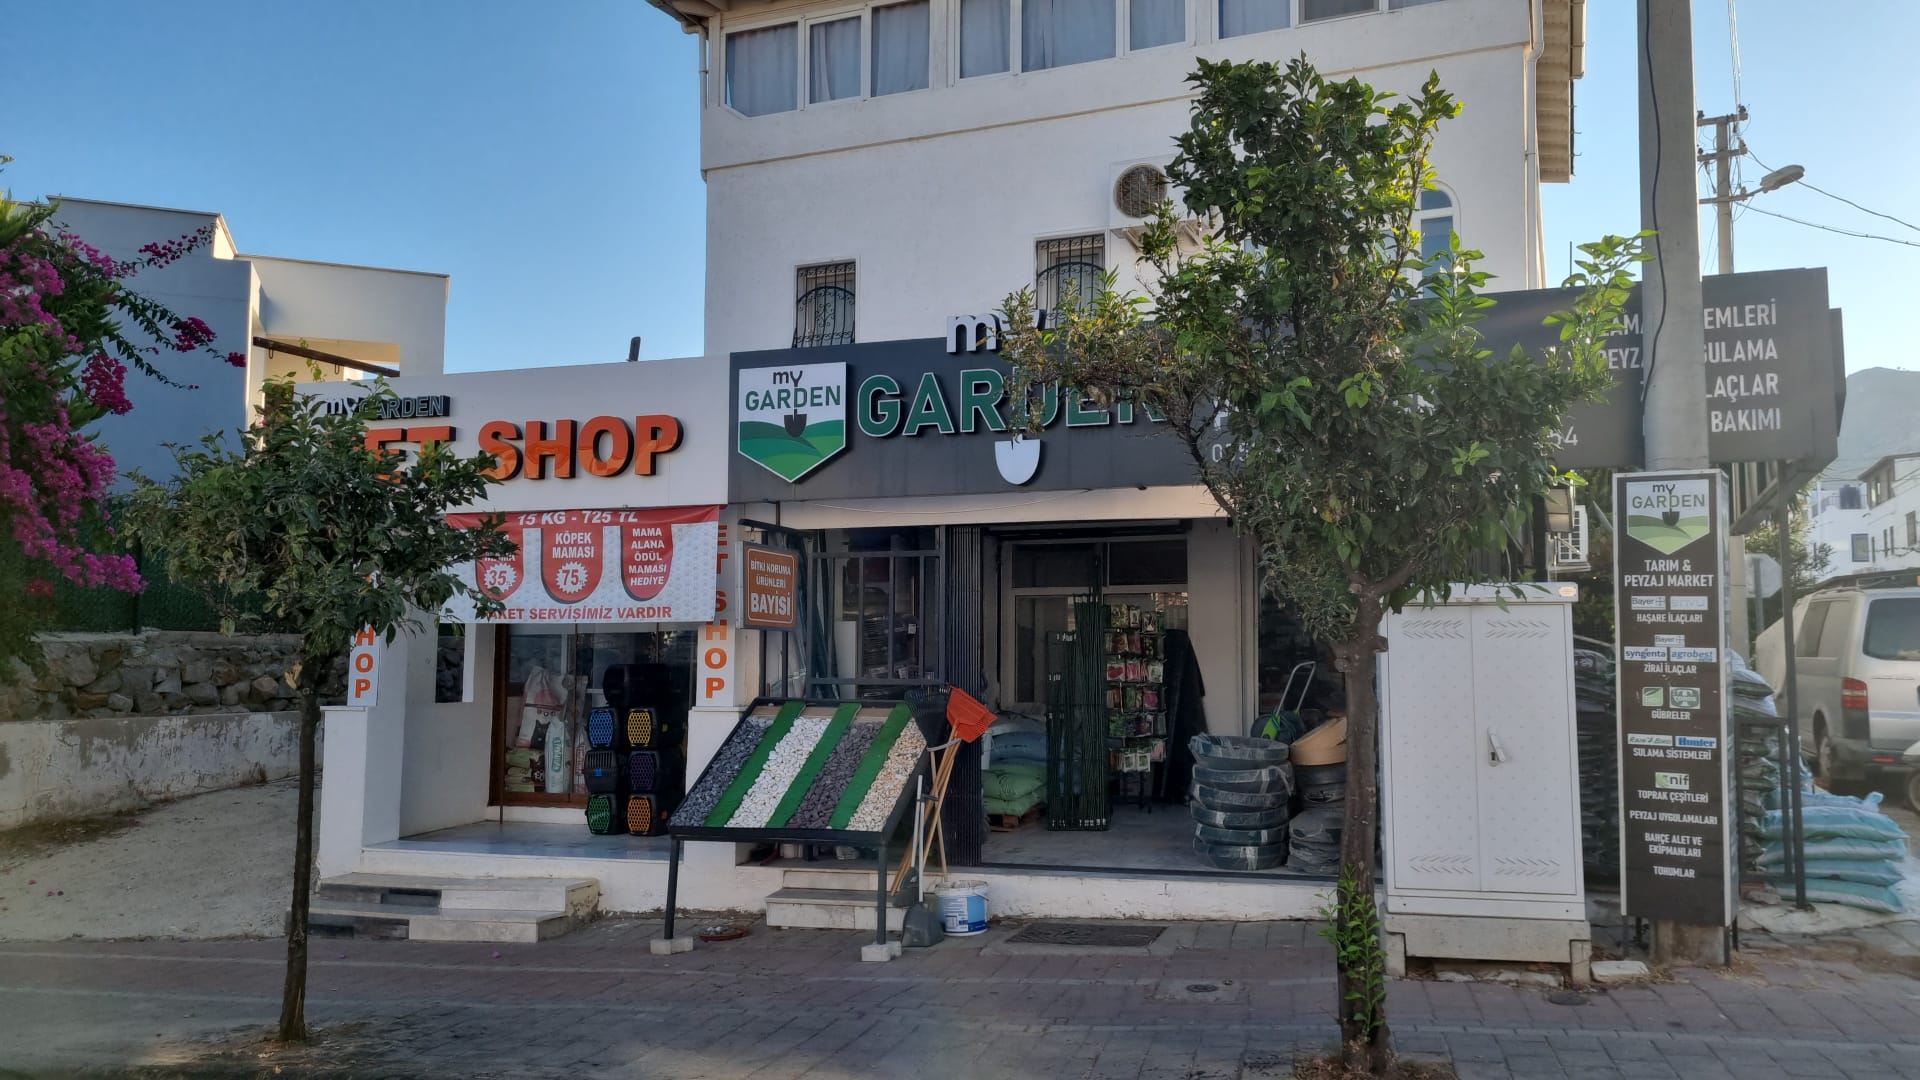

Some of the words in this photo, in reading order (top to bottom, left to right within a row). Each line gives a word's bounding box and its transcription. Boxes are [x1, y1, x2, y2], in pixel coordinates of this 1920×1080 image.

[1703, 298, 1777, 330] EMLERİ
[1703, 339, 1779, 364] ULAMA
[773, 365, 803, 387] my
[1705, 372, 1779, 403] AÇLAR
[745, 385, 841, 411] GARDEN
[1710, 407, 1781, 433] BAKIMI
[477, 414, 684, 482] SHOP
[1652, 484, 1675, 495] my
[1632, 494, 1705, 509] GARDEN
[518, 513, 537, 526] 15
[541, 511, 567, 525] KG
[582, 510, 613, 524] 725
[555, 530, 592, 545] KÖPEK
[632, 527, 662, 537] MAMA
[631, 540, 665, 550] ALANA
[552, 546, 595, 559] MAMASI
[634, 550, 662, 562] ÖDÜL
[628, 564, 667, 574] MAMASI
[1644, 560, 1679, 572] TARIM
[1682, 559, 1692, 572] &
[489, 570, 507, 585] 35
[562, 569, 579, 586] 75
[630, 575, 664, 587] HEDİYE
[1624, 575, 1664, 587] PEYZAJ
[1667, 575, 1714, 587] MARKET
[751, 590, 791, 616] BAYİSİ
[486, 607, 524, 620] AKET
[529, 605, 612, 620] SERVİSİMİZ
[617, 606, 672, 619] VARDIR
[1636, 613, 1666, 624] HAŞARE
[1668, 611, 1703, 624] İLAÇLARI
[1625, 648, 1666, 659] syngenta
[355, 626, 375, 698] HOP
[1665, 662, 1697, 675] İLAÇLAR
[1651, 708, 1691, 720] GÜBRELER
[1633, 748, 1664, 757] SULAMA
[1665, 748, 1712, 760] SİSTEMLERİ
[1637, 790, 1668, 800] TOPRAK
[1669, 791, 1709, 803] ÇEŞİTLERİ
[1629, 810, 1657, 820] PEYZAJ
[1645, 832, 1670, 844] BAHÇE
[1671, 834, 1690, 845] ALET
[1691, 836, 1703, 846] VE
